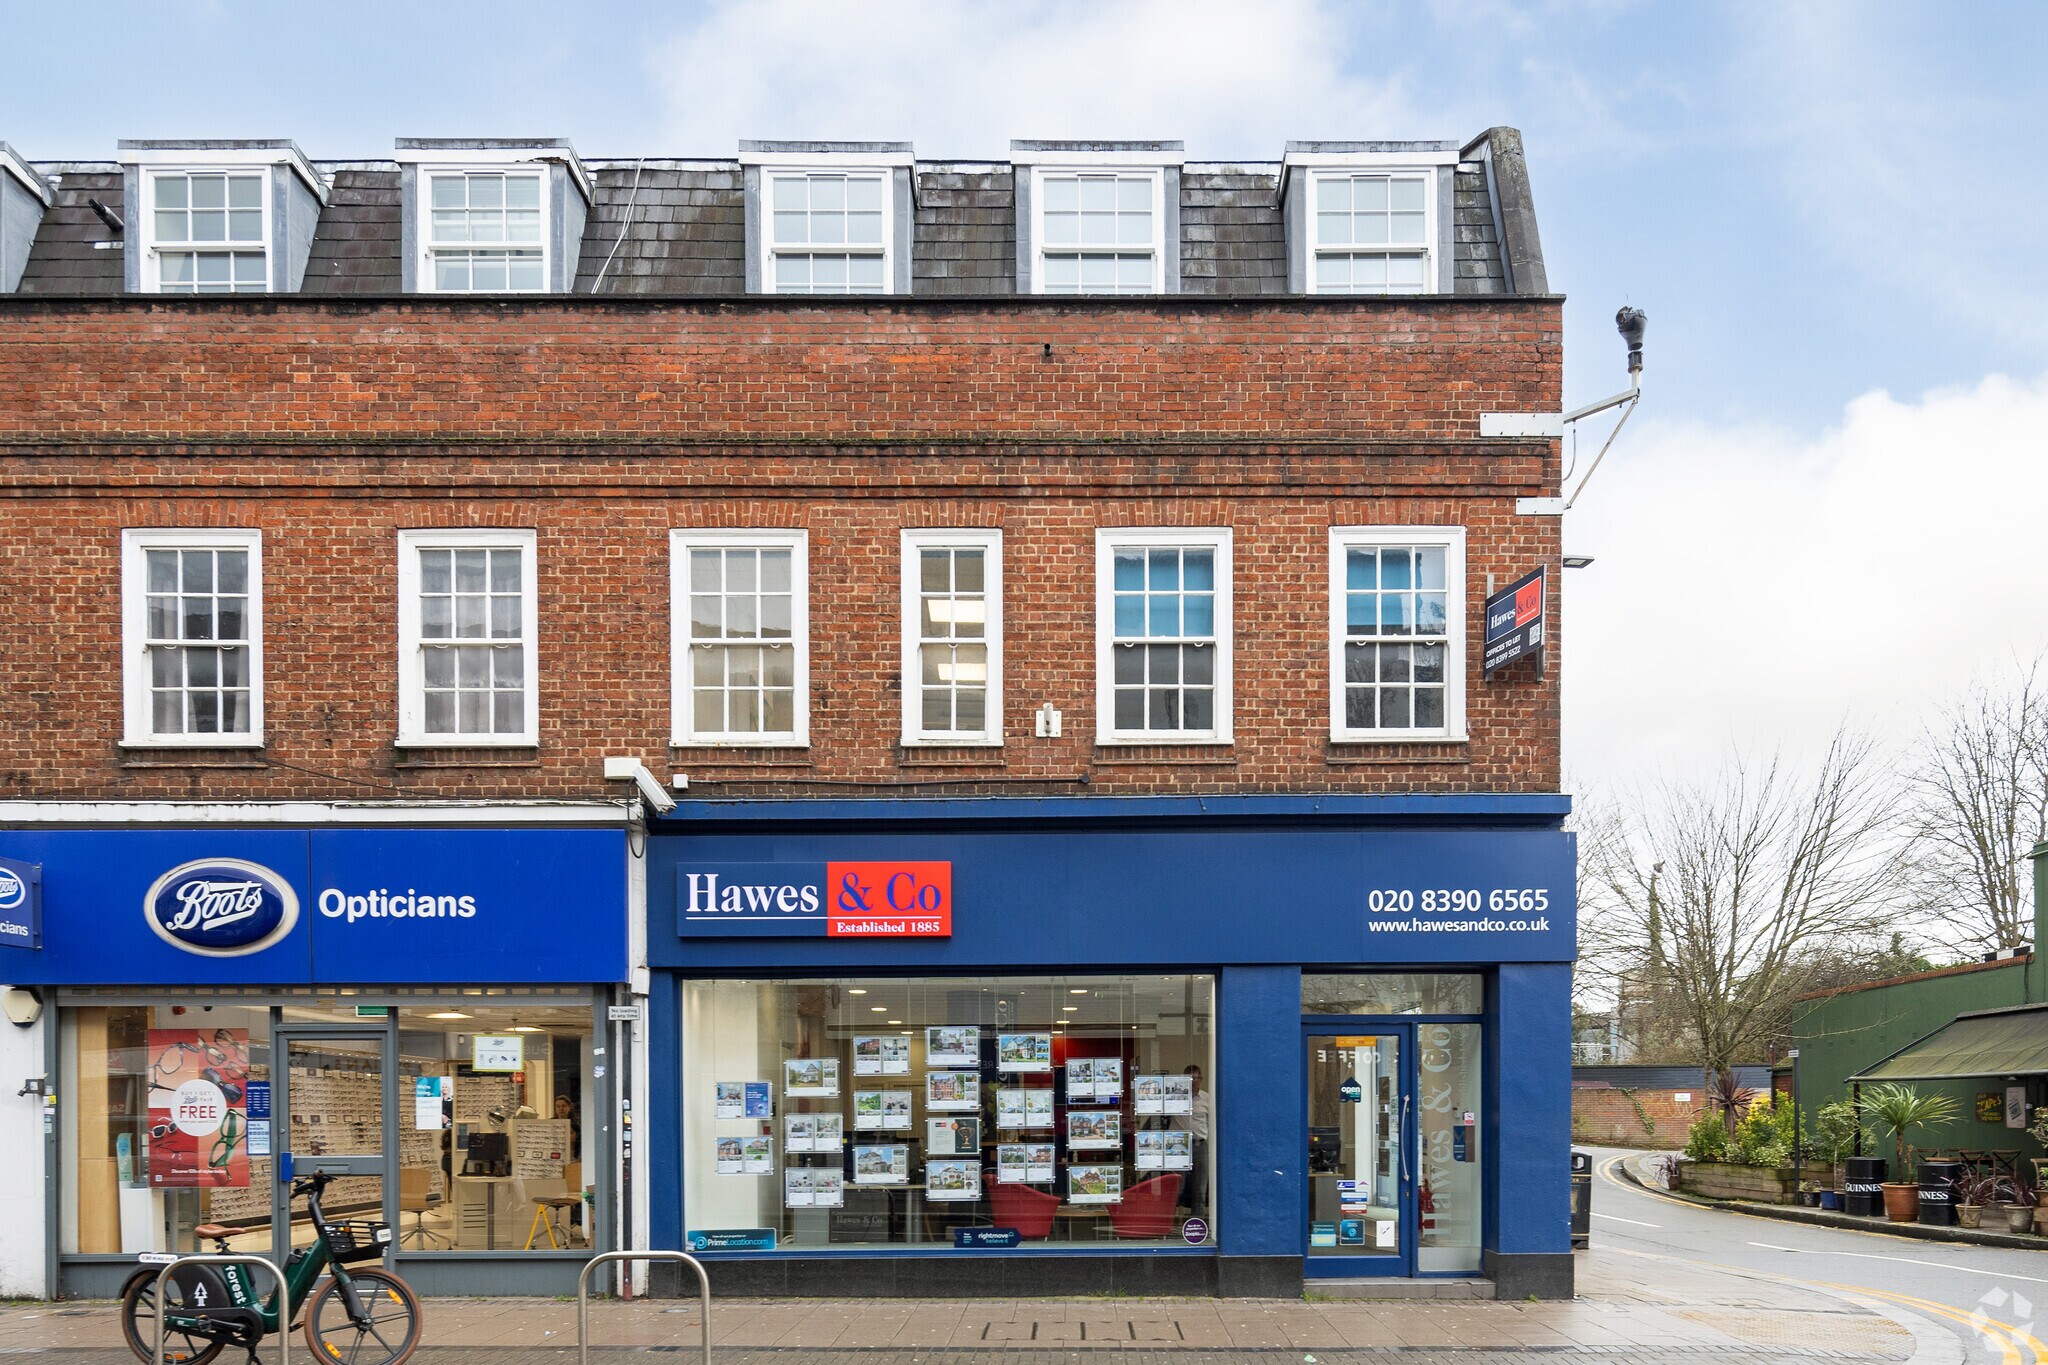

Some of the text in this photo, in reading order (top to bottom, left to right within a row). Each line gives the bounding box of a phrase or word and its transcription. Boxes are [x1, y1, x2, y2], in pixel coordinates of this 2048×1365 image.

[1490, 608, 1516, 629] Hawes
[1517, 601, 1524, 614] &
[1526, 595, 1537, 609] Co
[1486, 634, 1521, 658] OFFICES TO LET
[1486, 658, 1496, 669] 020
[0, 877, 18, 898] oots
[686, 872, 942, 913] Hawes & Co
[166, 881, 263, 931] Boots
[318, 888, 477, 924] Opticians
[1368, 888, 1549, 912] 020 8390 6565
[0, 920, 28, 937] cians
[837, 921, 940, 933] Established 1885
[1368, 916, 1550, 932] www.hawesandco.co.uk
[1341, 1086, 1361, 1094] open
[180, 1105, 217, 1119] FREE
[1421, 1026, 1451, 1238] Hawes & Co
[1845, 1182, 1883, 1192] GUINNES
[1918, 1190, 1949, 1200] NNESS
[707, 1237, 769, 1246] PrimeLocation.com
[978, 1232, 1009, 1240] rightmove
[224, 1264, 247, 1305] forest
